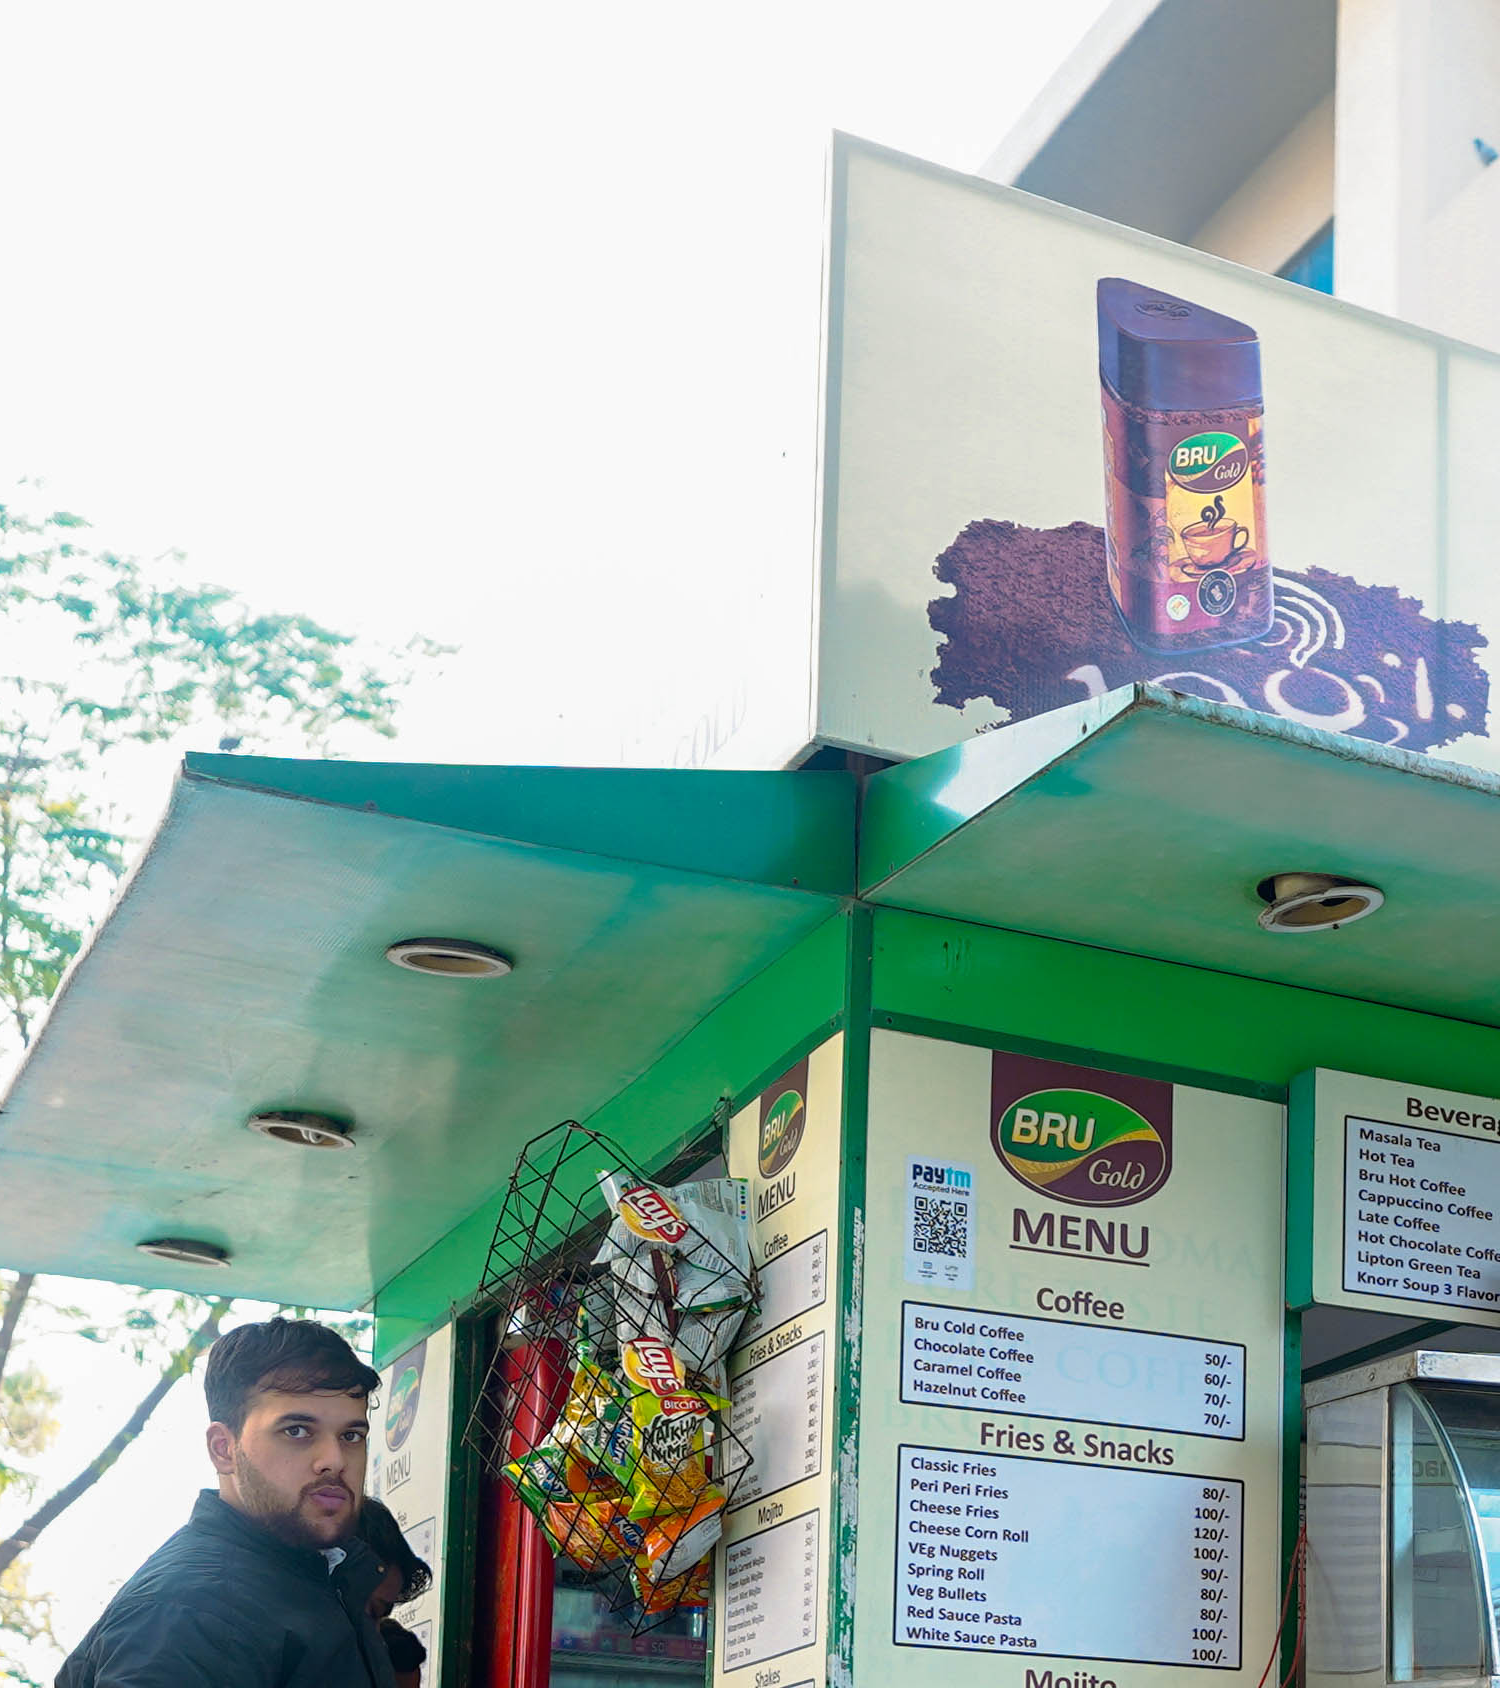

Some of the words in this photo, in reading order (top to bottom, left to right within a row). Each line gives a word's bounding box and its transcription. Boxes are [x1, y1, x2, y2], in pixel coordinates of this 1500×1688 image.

[1175, 444, 1218, 468] BRU
[1213, 462, 1241, 481] Gold
[763, 1111, 788, 1150] BRU
[779, 1127, 799, 1157] Gold
[1011, 1107, 1097, 1152] BRU
[1359, 1127, 1412, 1147] Masala
[1416, 1137, 1440, 1152] Tea
[912, 1163, 971, 1189] paytm
[1087, 1158, 1147, 1191] Gold
[758, 1172, 796, 1219] MENU
[912, 1181, 950, 1193] Accepted
[951, 1187, 970, 1196] Here
[1358, 1188, 1443, 1213] Cappuccino
[1447, 1203, 1493, 1221] Coffee
[1013, 1207, 1149, 1259] MENU
[764, 1233, 788, 1259] Coffee
[1357, 1250, 1404, 1268] Lipton
[1408, 1258, 1452, 1275] Green
[1456, 1264, 1481, 1279] Tea
[1036, 1287, 1124, 1320] Coffee
[915, 1316, 939, 1331] Bru
[943, 1320, 975, 1335] Cold
[979, 1324, 1024, 1341] Coffee
[749, 1345, 767, 1366] Fries
[775, 1323, 803, 1350] Snacks
[1204, 1353, 1231, 1369] 50/-
[913, 1379, 977, 1398] Hazelnut
[980, 1386, 1026, 1403] Coffee
[1203, 1412, 1231, 1428] 70/-
[980, 1422, 1044, 1451] Fries
[1052, 1429, 1075, 1455] &
[1083, 1433, 1174, 1466] Snacks
[386, 1451, 411, 1490] MENU
[910, 1478, 938, 1492] Peri
[942, 1481, 970, 1495] Peri
[975, 1484, 1008, 1499] Fries
[757, 1503, 783, 1526] Mojito
[908, 1520, 960, 1536] Cheese
[964, 1525, 998, 1540] Corn
[1002, 1528, 1028, 1543] Roll
[1194, 1527, 1224, 1543] 120/-
[908, 1541, 935, 1558] VEg
[939, 1544, 998, 1562] Nuggets
[905, 1626, 950, 1641] White
[953, 1630, 995, 1645] Sauce
[999, 1633, 1036, 1648] Pasta
